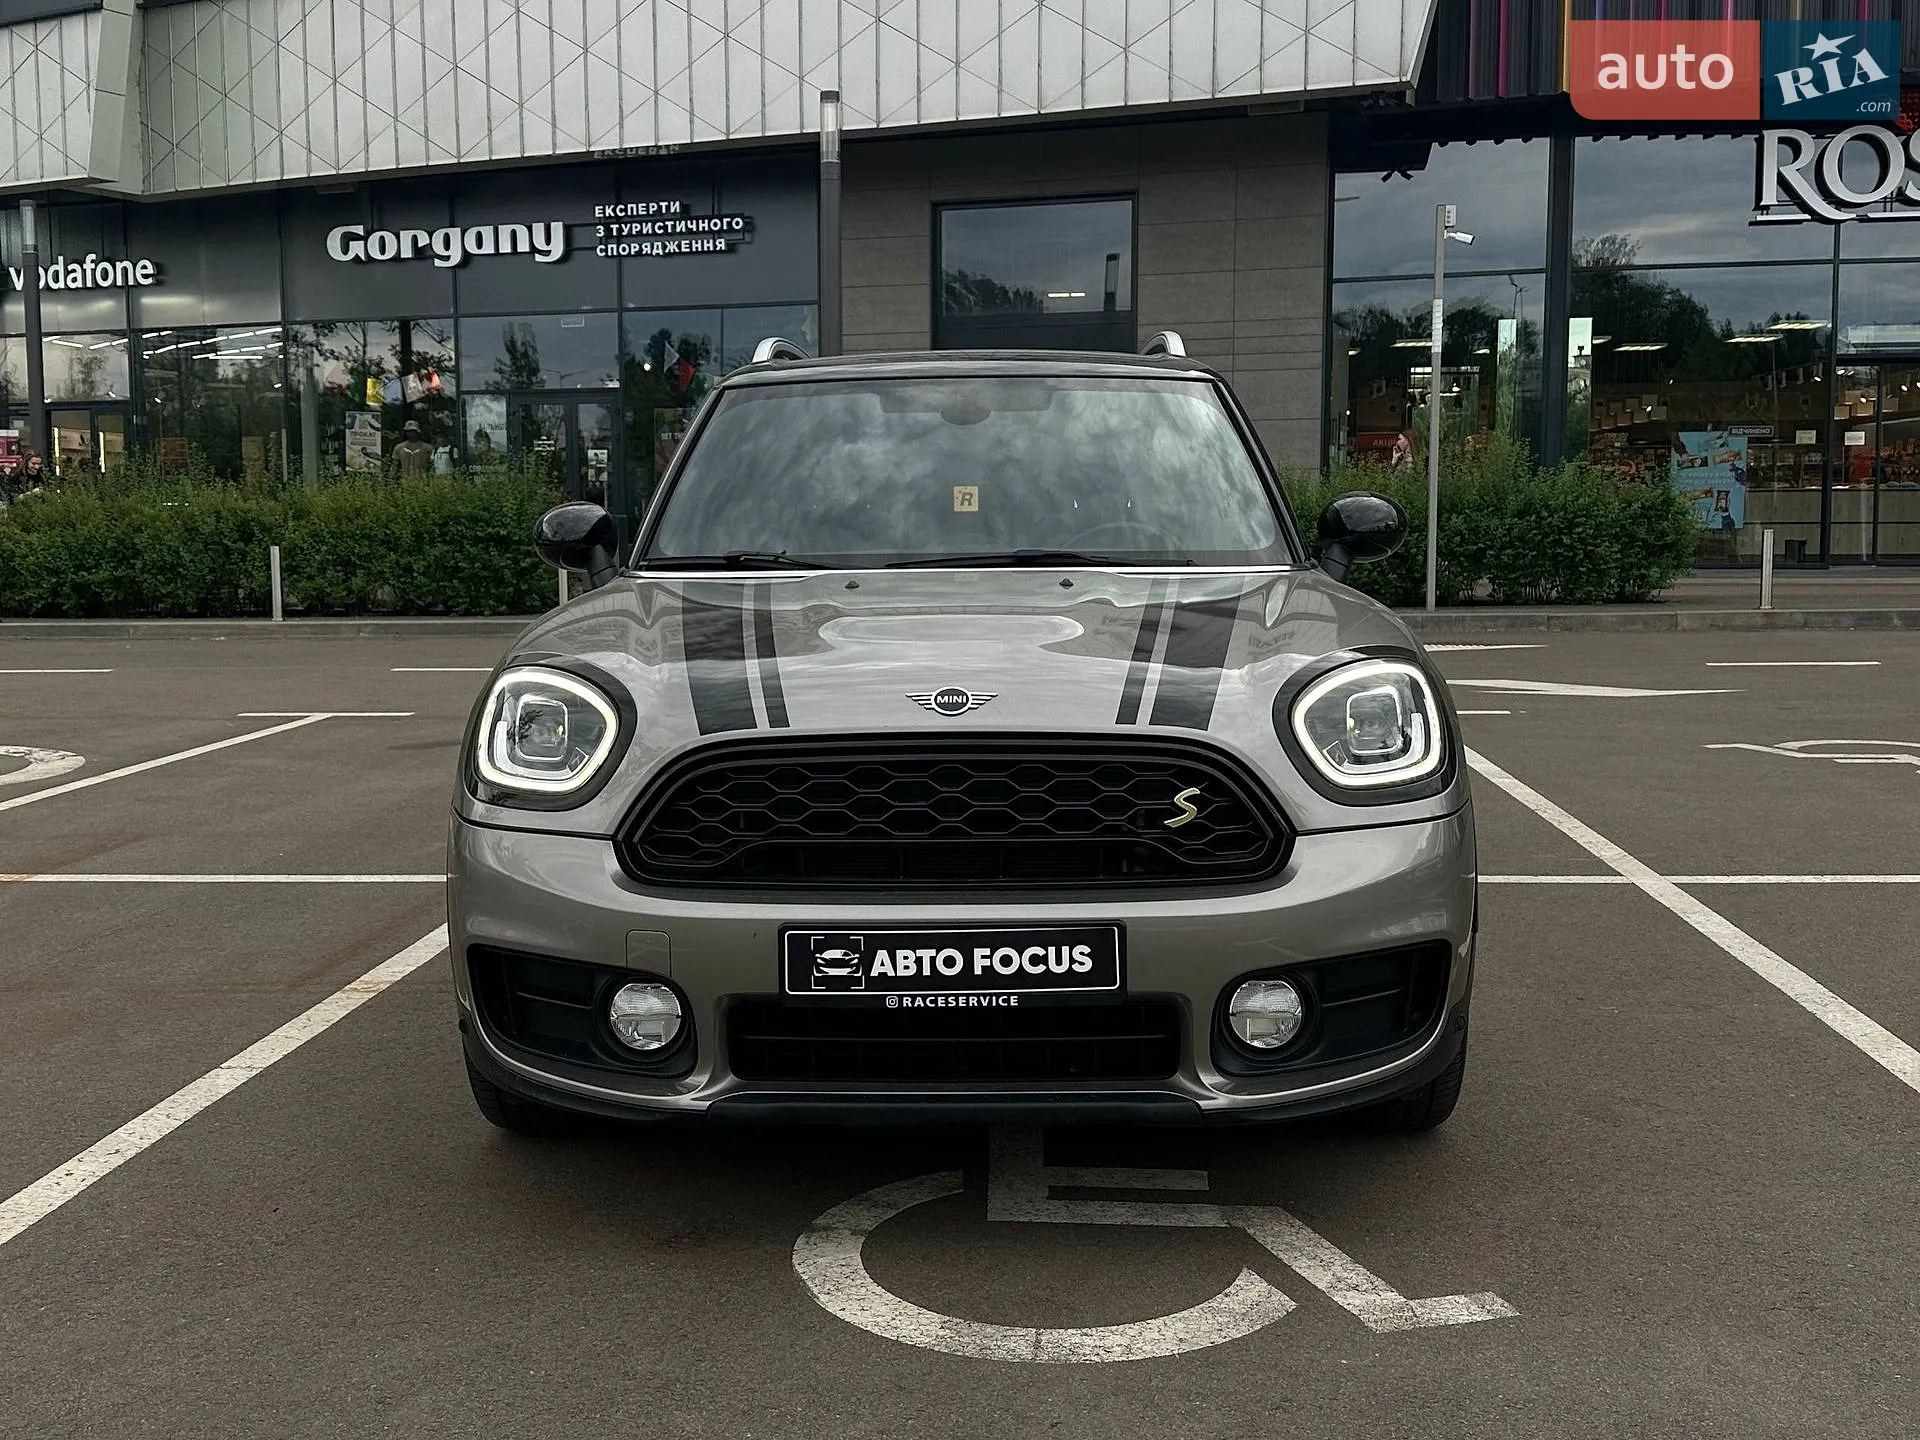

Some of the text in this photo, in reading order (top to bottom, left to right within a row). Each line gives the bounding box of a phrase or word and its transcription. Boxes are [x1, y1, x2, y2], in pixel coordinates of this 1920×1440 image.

[1760, 124, 1920, 221] RO
[594, 200, 681, 218] ЕКСПЕРТИ
[610, 217, 744, 236] ТУРИСТИЧНОГО
[326, 221, 566, 268] Gorgany
[596, 238, 726, 257] СПОРЯДЖЕННЯ
[936, 695, 967, 704] MINI
[1164, 787, 1201, 828] S
[870, 944, 1093, 977] АВТО FOCUS
[902, 994, 1020, 1008] RACESERVICE
